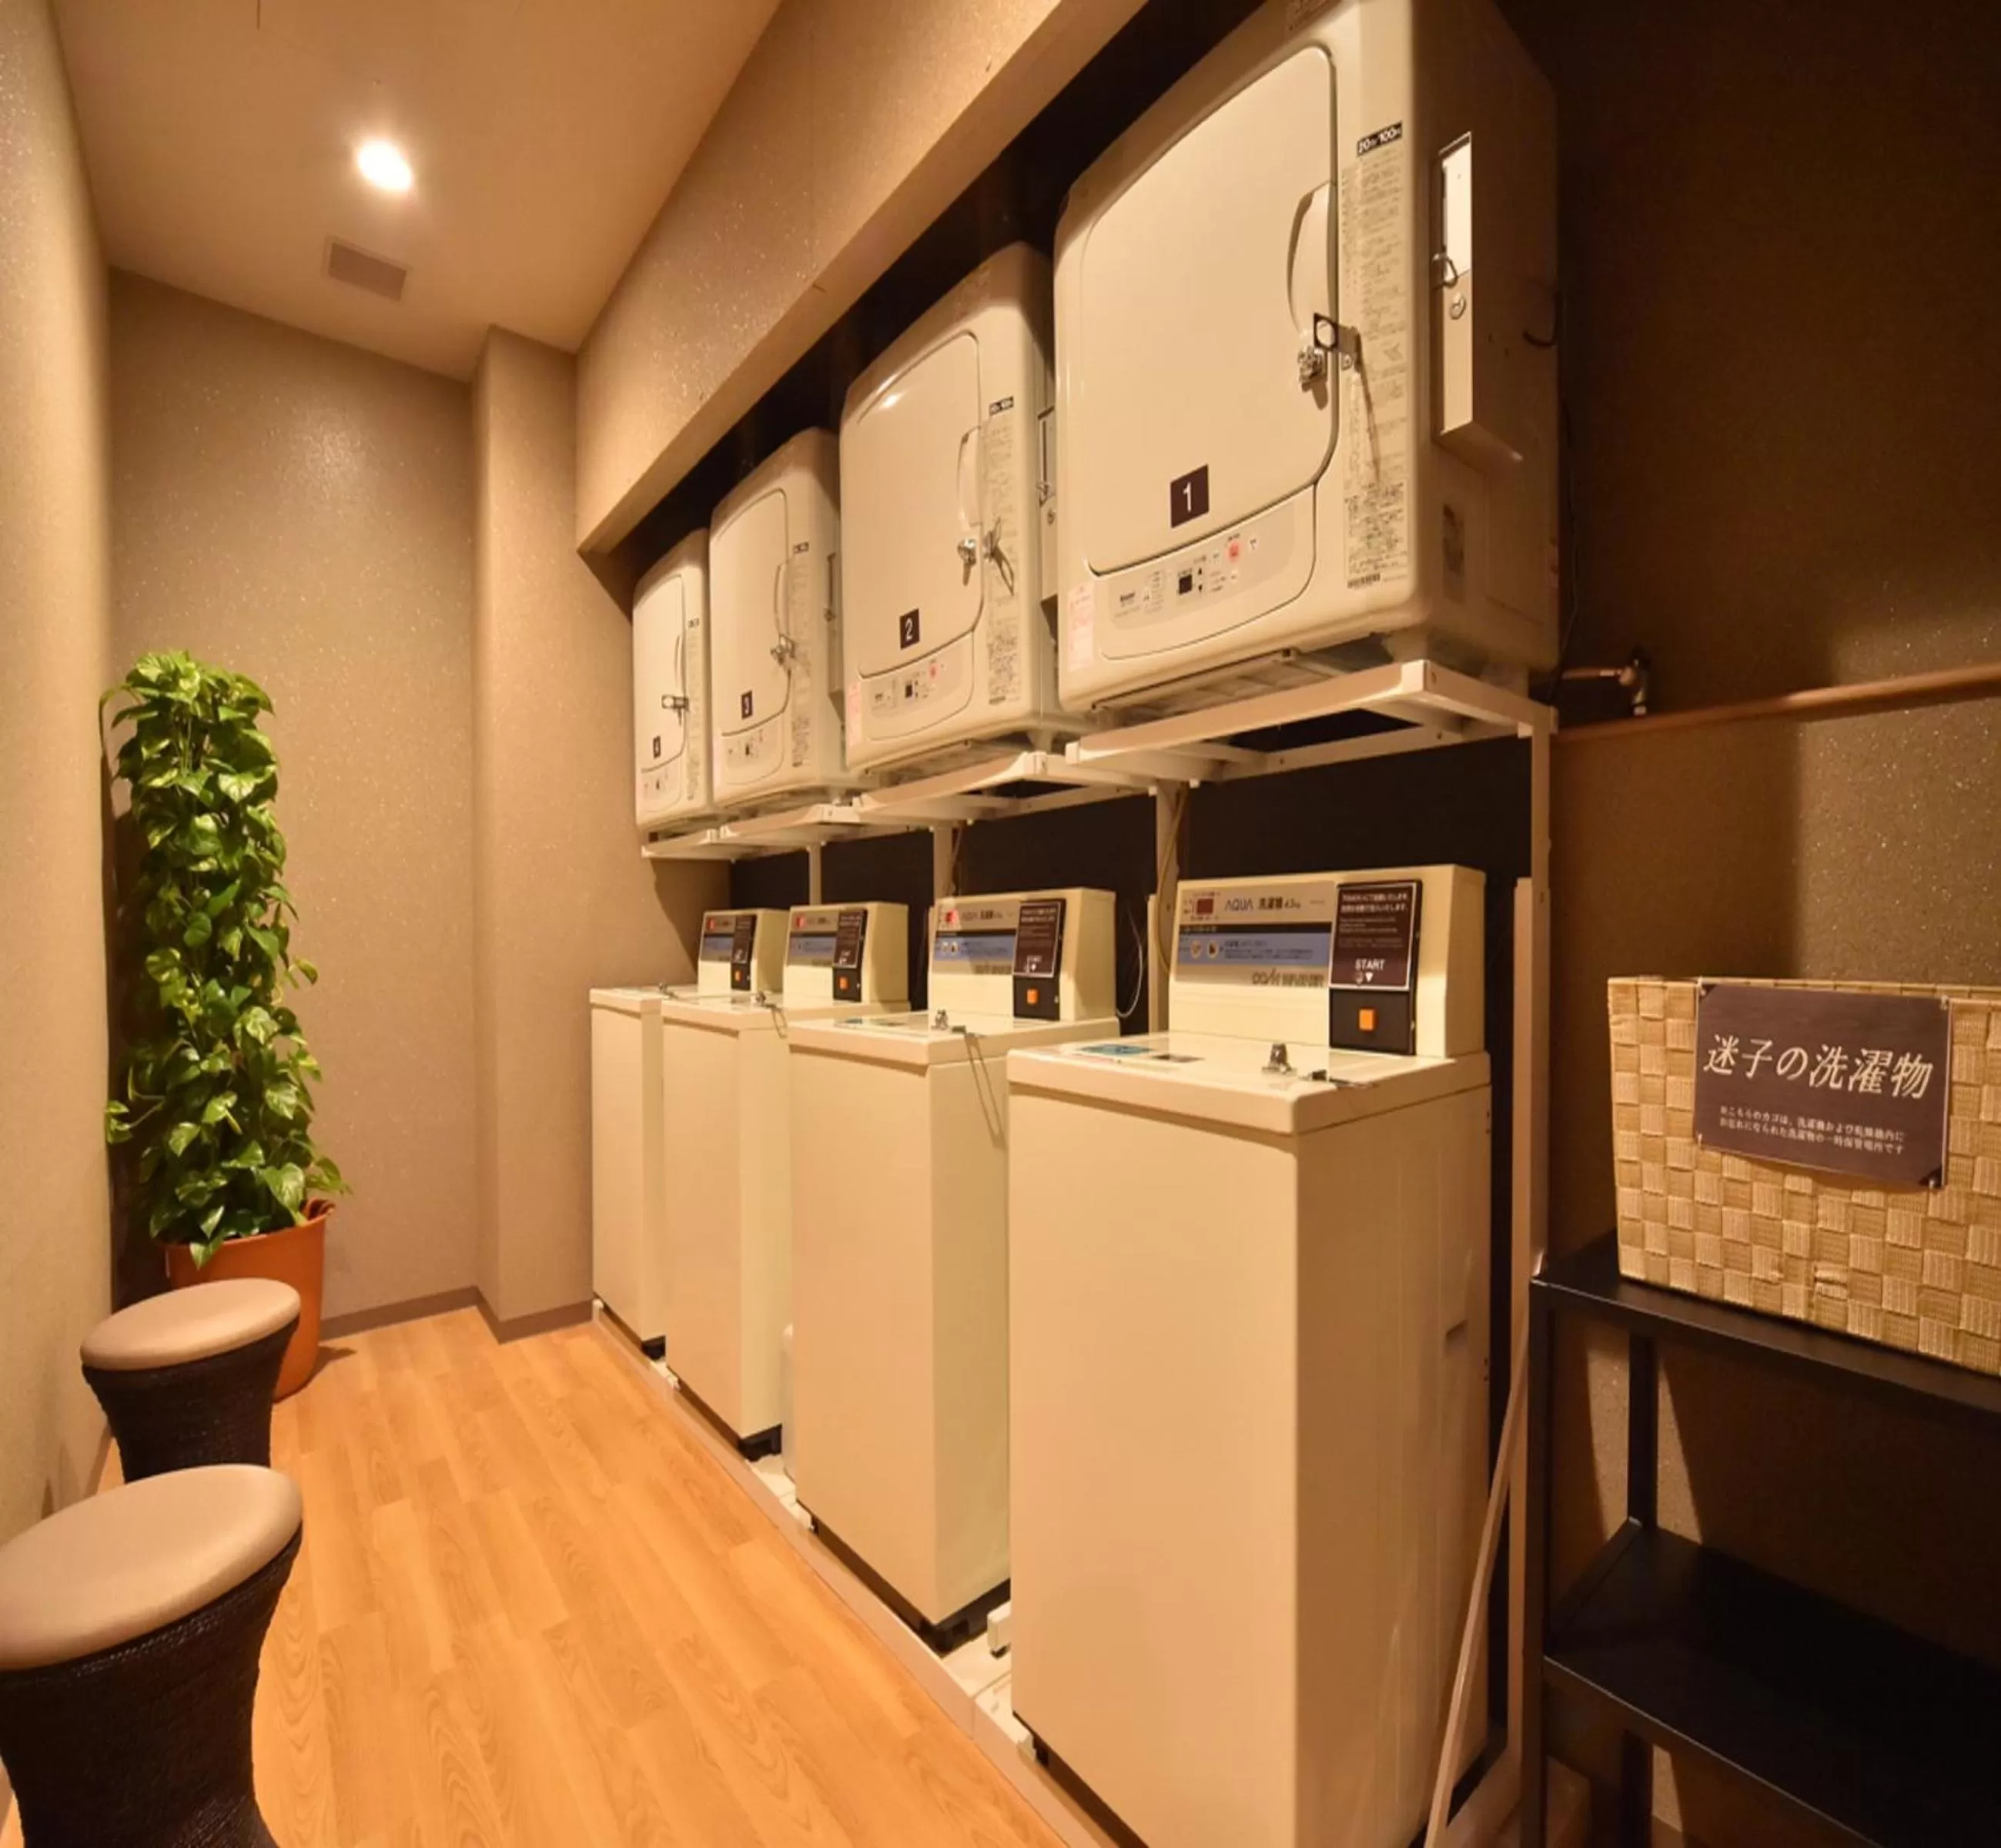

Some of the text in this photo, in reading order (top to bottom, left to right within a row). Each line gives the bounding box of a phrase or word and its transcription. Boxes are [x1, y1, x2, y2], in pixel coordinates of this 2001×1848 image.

[1183, 481, 1192, 512] 1
[905, 618, 913, 641] 2
[1225, 897, 1254, 912] AQUA
[1355, 958, 1386, 971] START
[1703, 1034, 1934, 1100] 迷子の洗濯物
